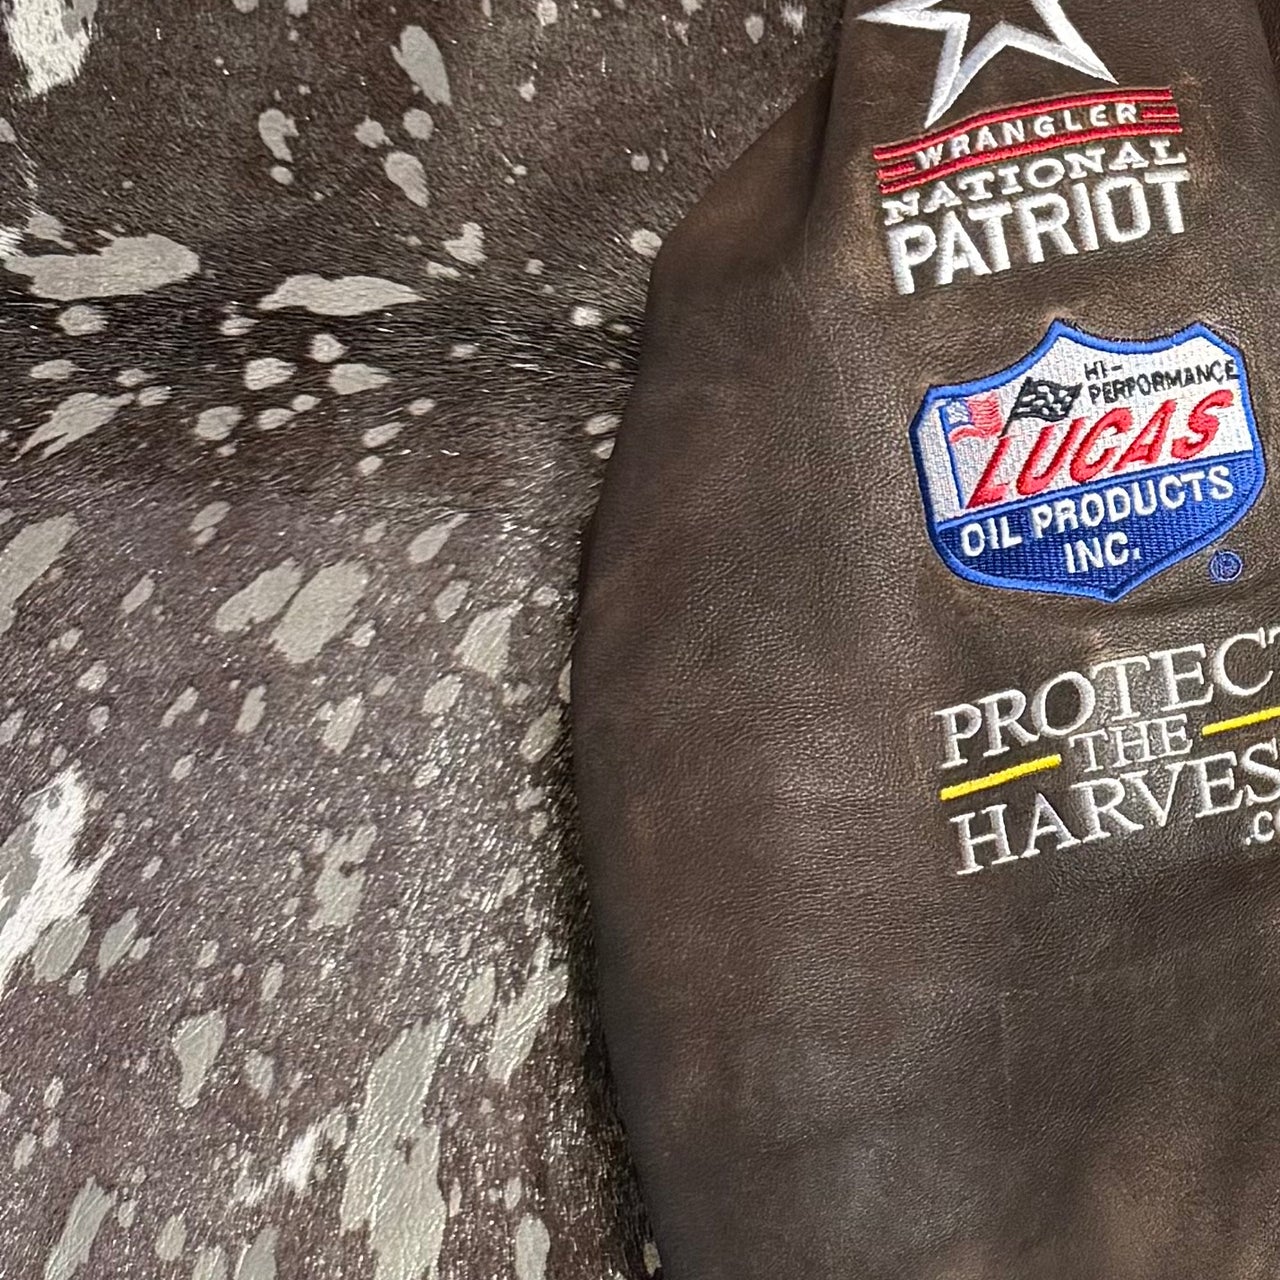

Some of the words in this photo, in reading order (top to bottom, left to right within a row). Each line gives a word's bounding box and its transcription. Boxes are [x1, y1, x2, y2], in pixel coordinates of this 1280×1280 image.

[915, 101, 1138, 170] WRANGLER
[881, 137, 1187, 226] NATIONAL
[886, 169, 1190, 295] PATRIOT
[1084, 360, 1123, 381] HI-
[1088, 361, 1239, 406] PERFORMANCE
[966, 388, 1236, 510] LUCAS
[960, 516, 1023, 558] OIL
[1031, 464, 1235, 539] PRODUCTS
[1063, 531, 1141, 574] INC.
[1068, 713, 1194, 773] THE
